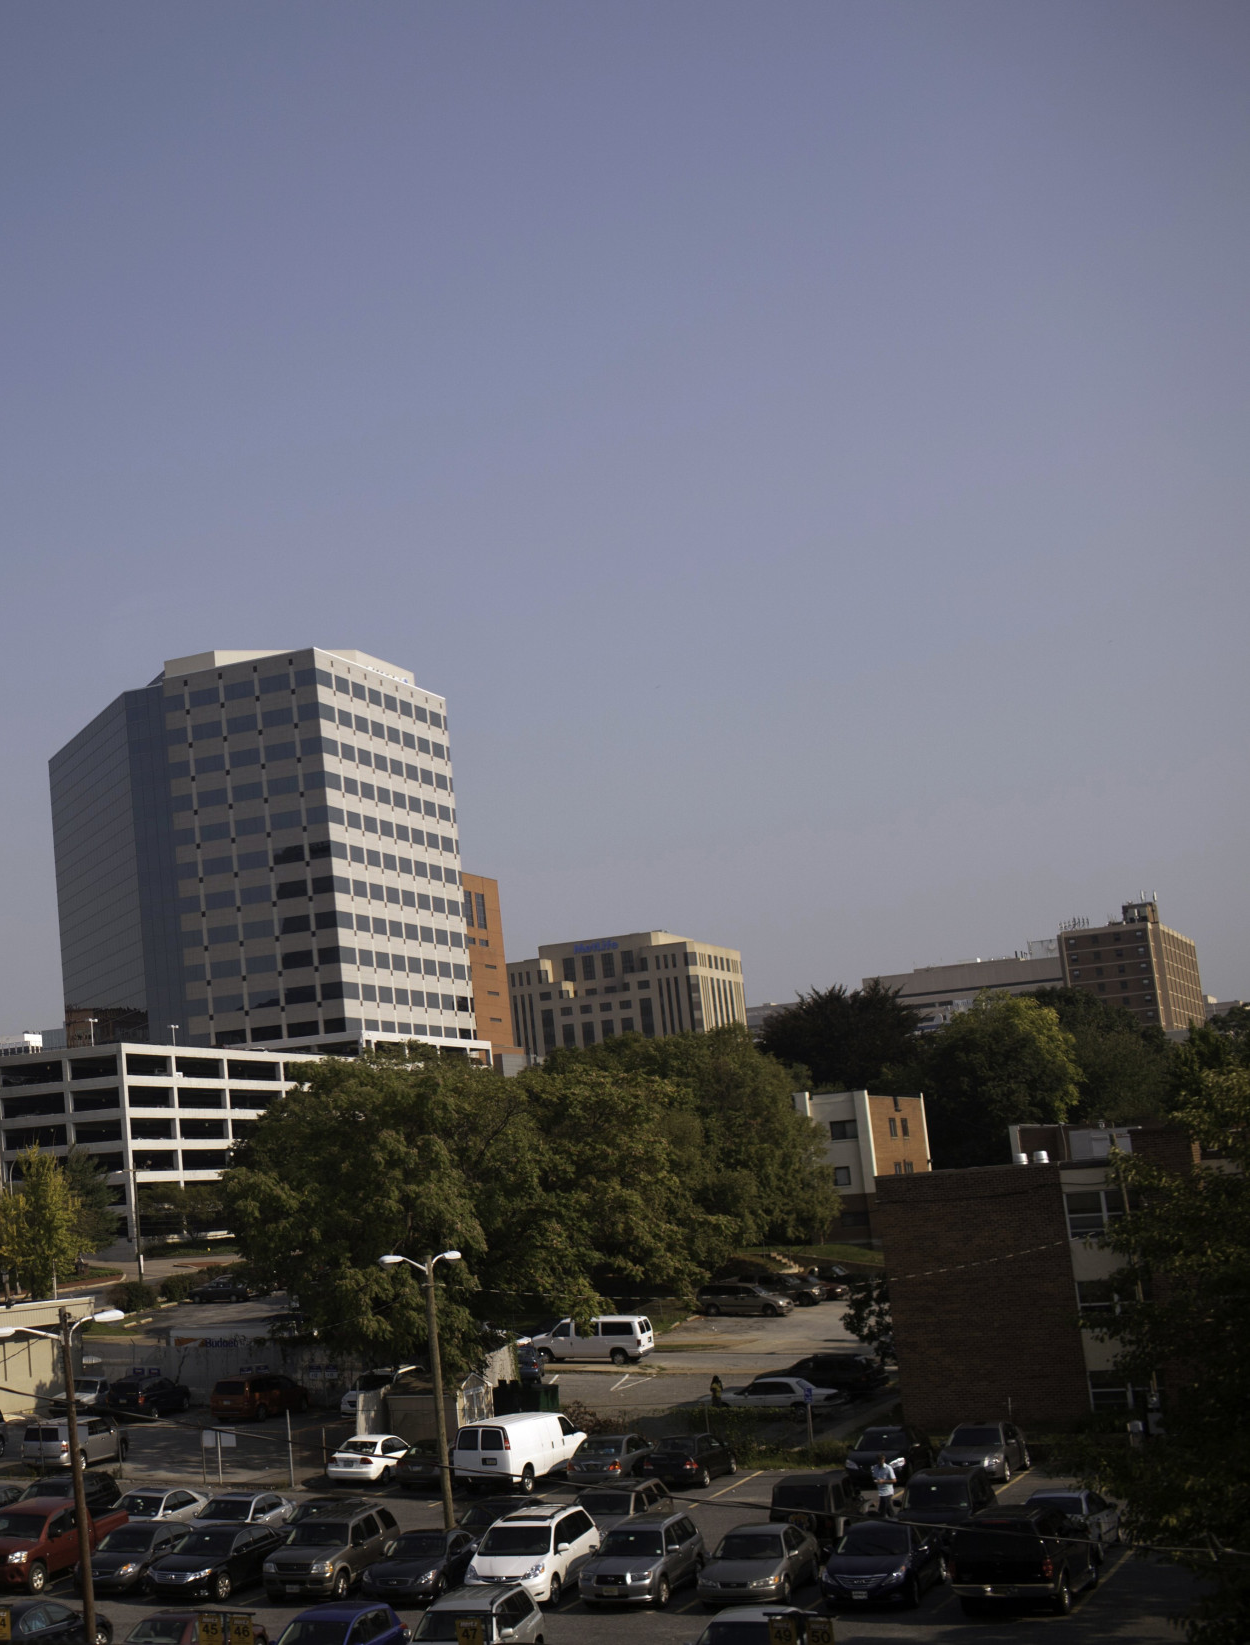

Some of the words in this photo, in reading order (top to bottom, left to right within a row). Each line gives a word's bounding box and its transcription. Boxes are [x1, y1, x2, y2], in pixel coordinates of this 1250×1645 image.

[573, 939, 619, 954] MetLife
[202, 1623, 218, 1635] 45
[234, 1626, 250, 1637] 46
[461, 1628, 477, 1640] 47
[774, 1630, 792, 1642] 49
[811, 1631, 830, 1643] 50
